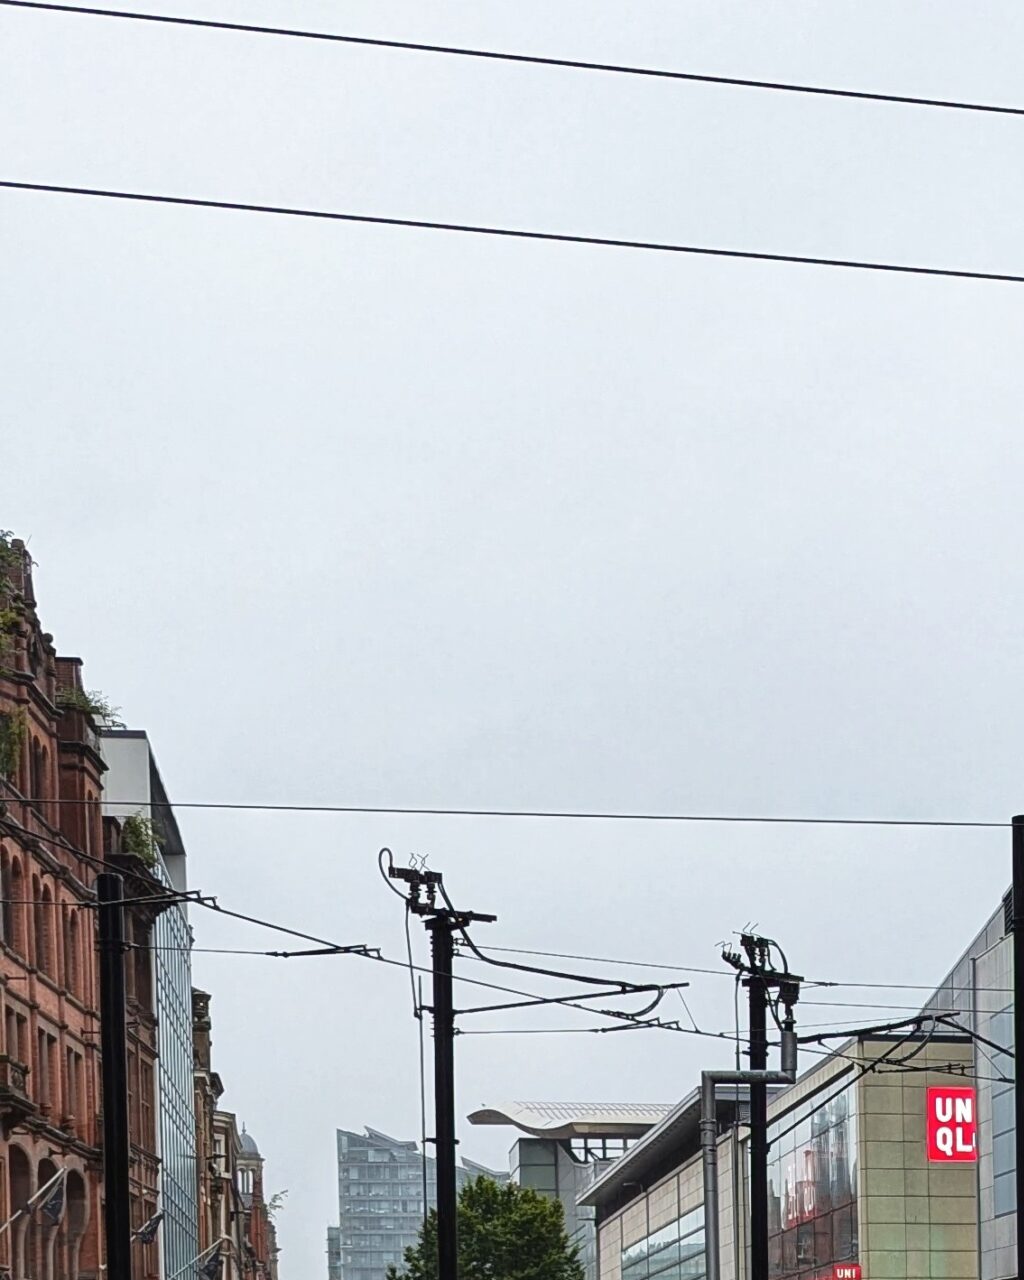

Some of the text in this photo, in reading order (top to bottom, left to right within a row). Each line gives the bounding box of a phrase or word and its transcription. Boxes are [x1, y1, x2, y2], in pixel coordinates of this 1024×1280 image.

[935, 1097, 973, 1123] UN
[936, 1127, 976, 1156] QL
[837, 1269, 856, 1279] UNI
